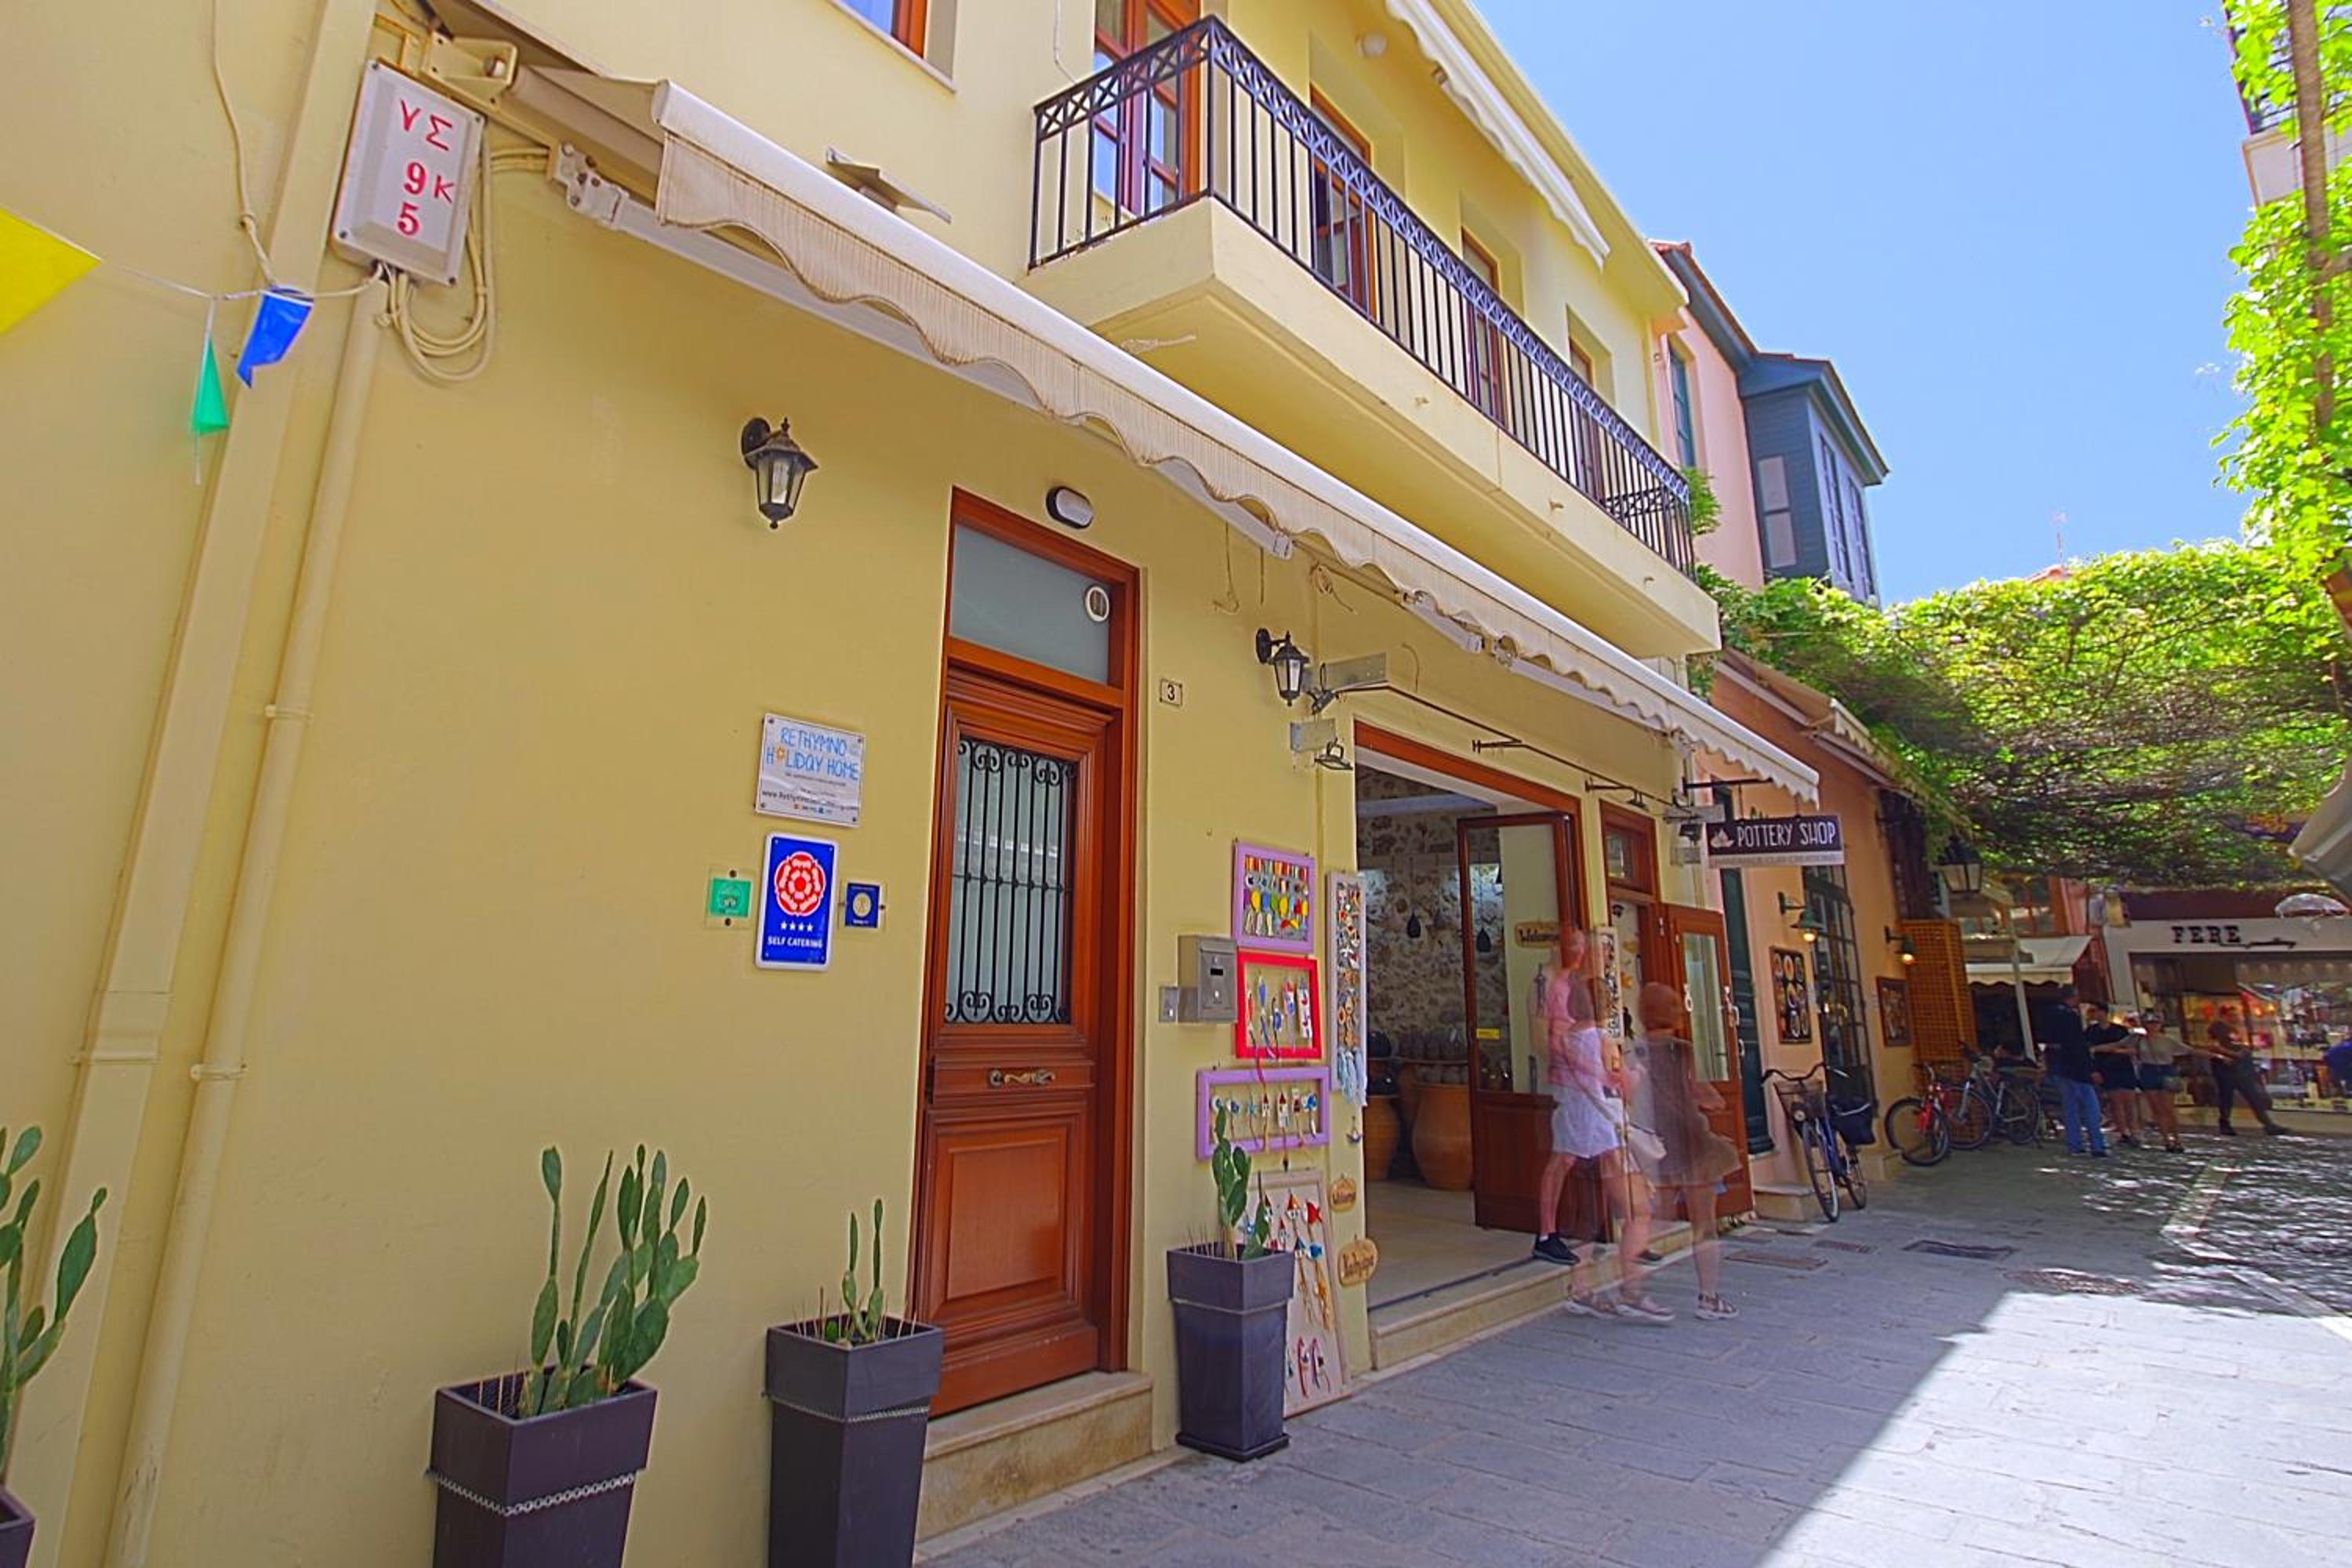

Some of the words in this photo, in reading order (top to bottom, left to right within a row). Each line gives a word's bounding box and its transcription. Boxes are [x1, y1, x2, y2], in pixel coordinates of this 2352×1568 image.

[397, 202, 419, 235] 5
[1167, 684, 1174, 701] 3
[781, 726, 847, 757] RETHYMNO
[827, 758, 858, 780] HOME
[1737, 825, 1792, 848] POTTERY
[1800, 822, 1836, 845] SHOP
[768, 935, 786, 946] SELF
[786, 937, 822, 949] CATERING
[2171, 925, 2241, 943] FERE
